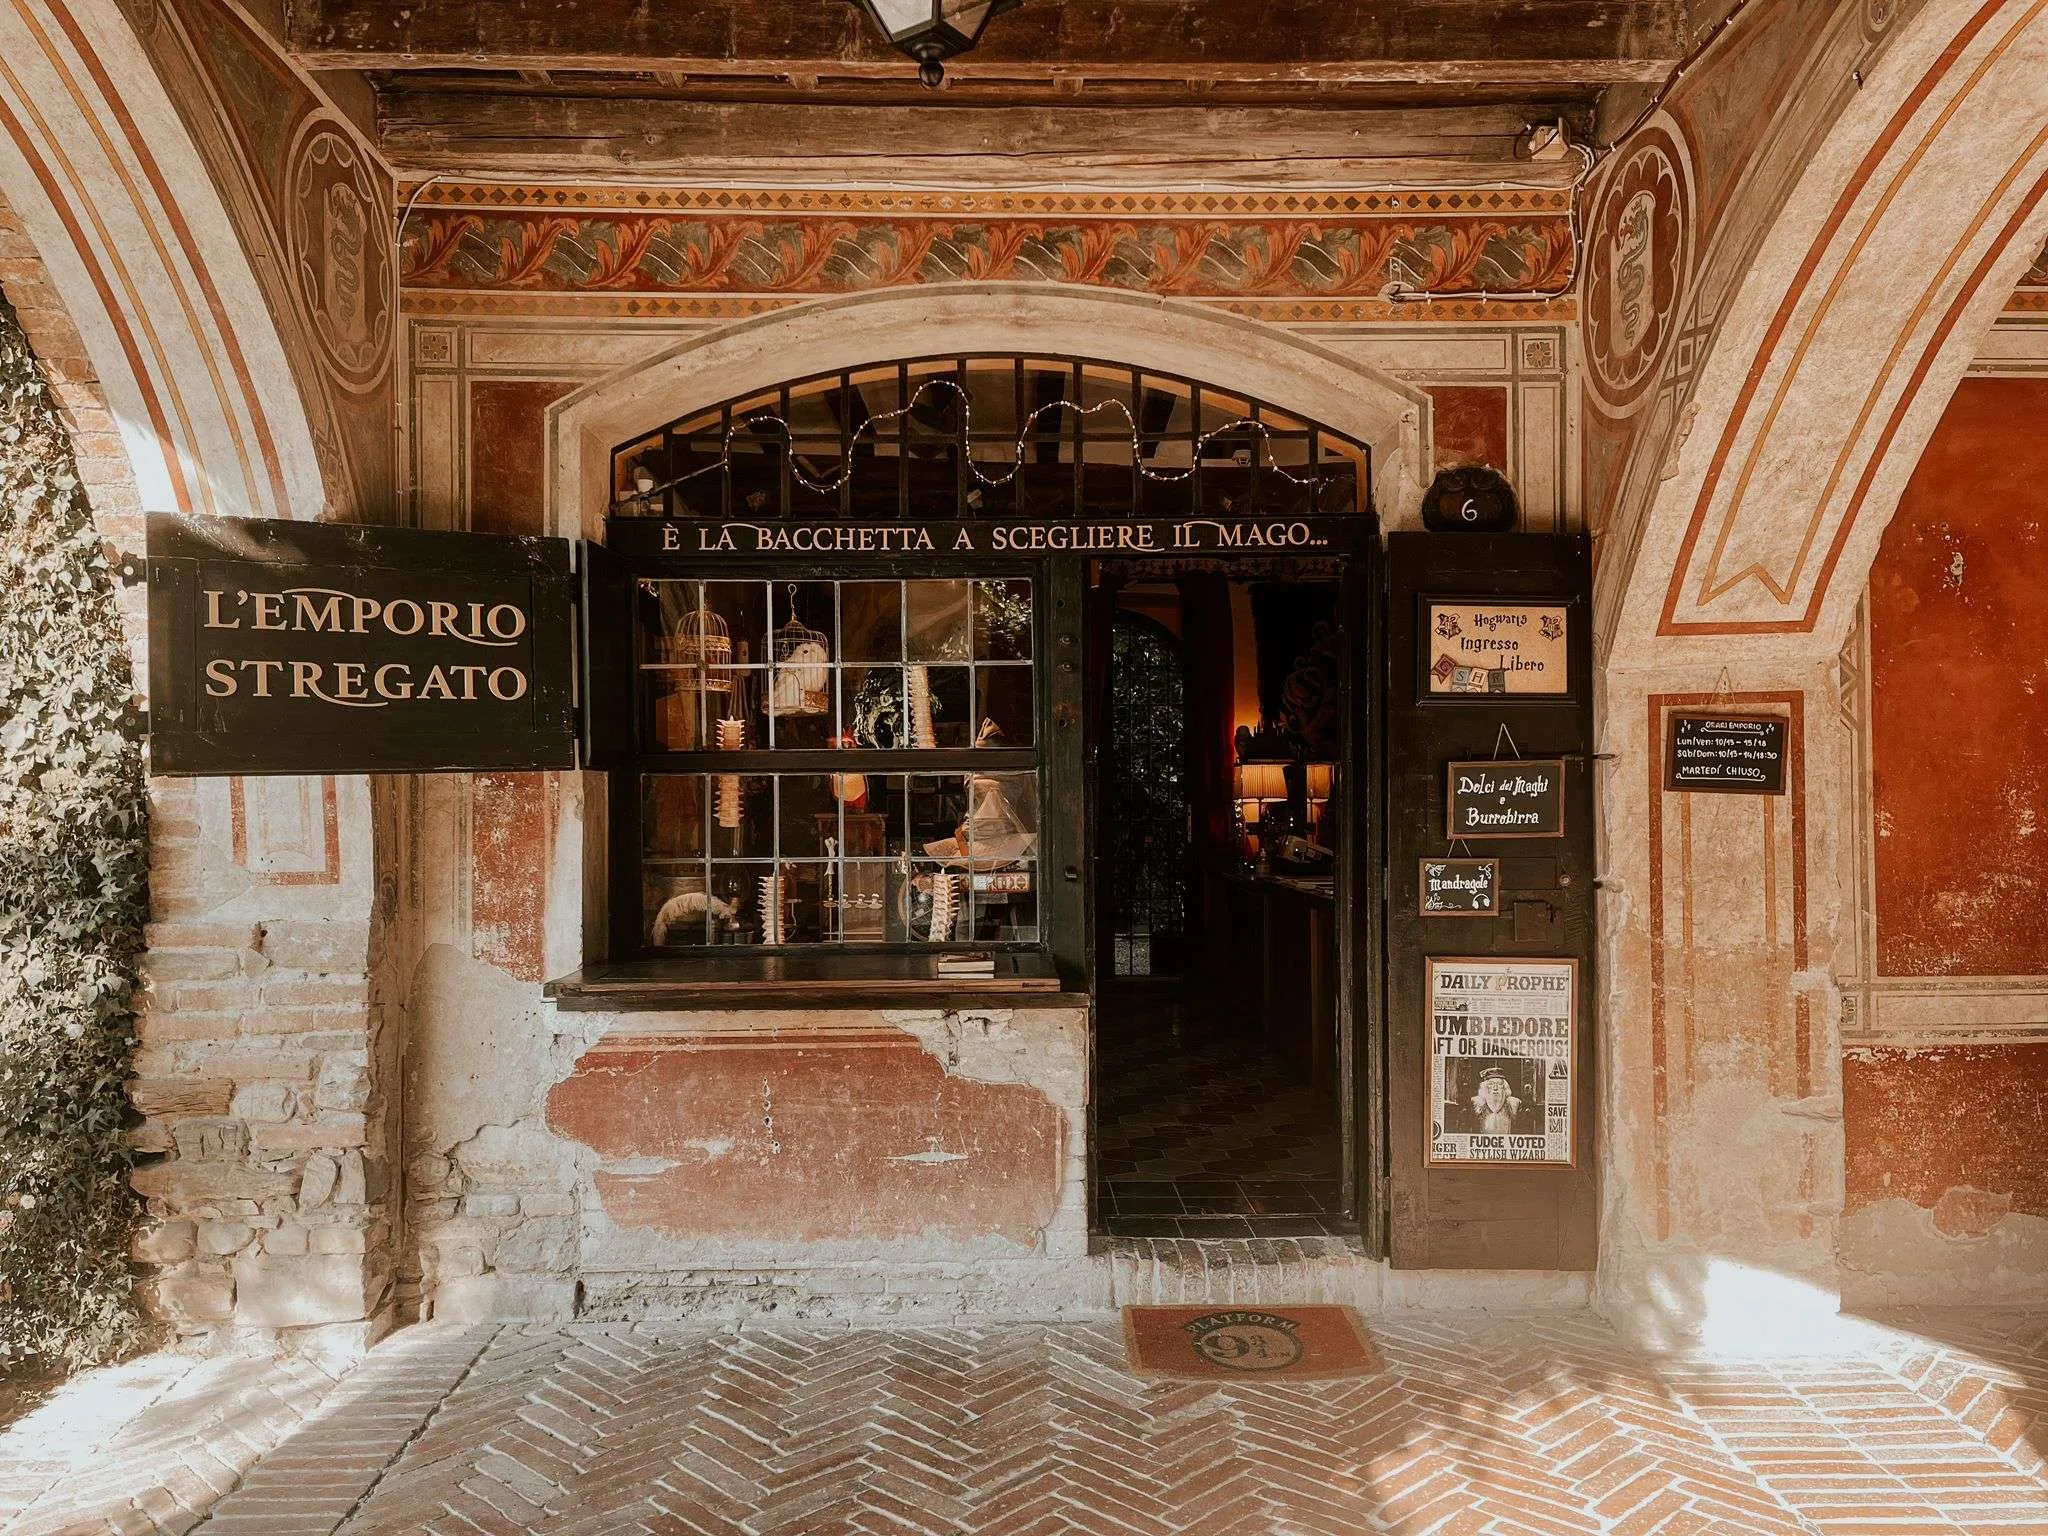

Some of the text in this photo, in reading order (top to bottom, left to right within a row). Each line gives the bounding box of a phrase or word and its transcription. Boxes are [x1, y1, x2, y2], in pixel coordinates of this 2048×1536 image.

[1462, 499, 1478, 521] 6
[662, 522, 1329, 552] È LA BACCHETTA A SCEGLIERE IL MAGO...
[203, 587, 527, 647] L'EMPORIO
[1474, 613, 1528, 632] Hogwarts
[1460, 637, 1519, 653] Ingresso
[1500, 654, 1545, 672] Libero
[205, 658, 528, 708] STREGATO
[1726, 766, 1761, 778] CHIUSO
[1457, 773, 1549, 798] Dolci dei Maghi
[1500, 796, 1506, 805] e
[1465, 806, 1540, 827] Burrobirra
[1440, 974, 1569, 992] DAILY PROPHE
[1458, 1038, 1477, 1056] OR
[1547, 1106, 1567, 1118] SAVE
[1469, 1136, 1505, 1149] FUDGE
[1508, 1136, 1546, 1149] VOTED
[1469, 1148, 1508, 1160] STYLISH
[1509, 1149, 1546, 1161] WIZARD
[1186, 1312, 1297, 1333] PLATFORM
